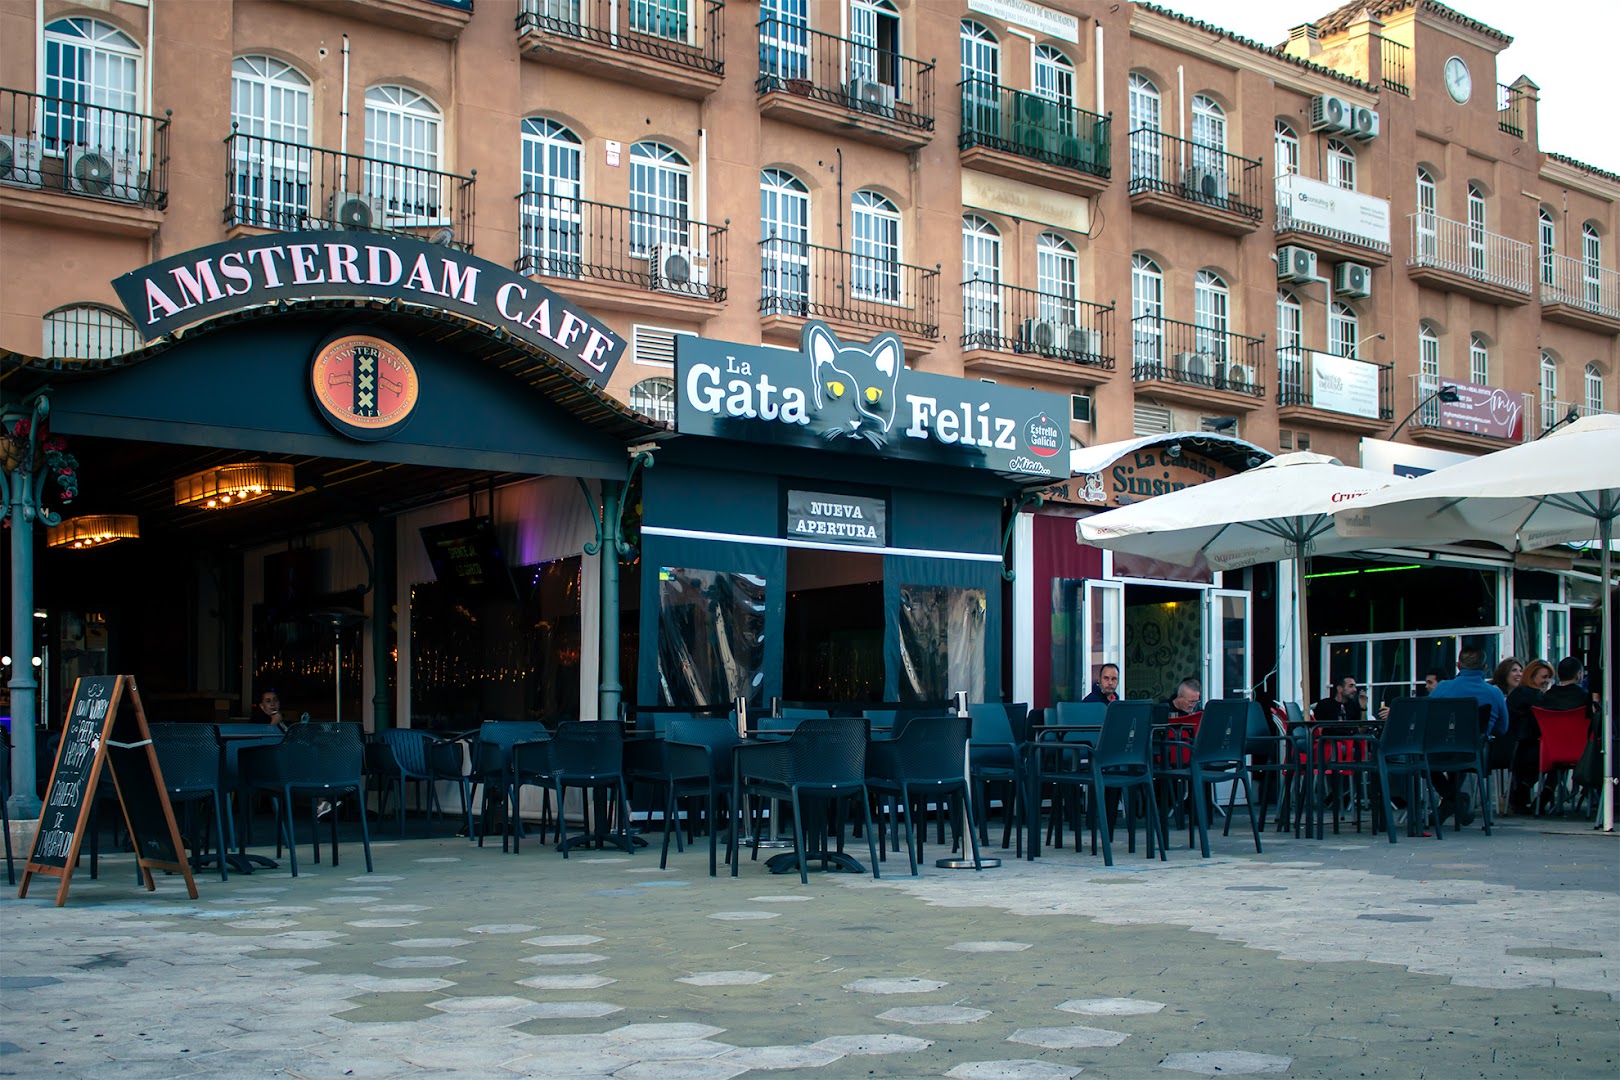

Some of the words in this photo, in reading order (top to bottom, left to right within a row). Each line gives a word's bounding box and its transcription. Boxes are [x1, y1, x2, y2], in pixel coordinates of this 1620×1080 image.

[145, 243, 483, 325] AMSTERDAM
[495, 281, 616, 374] CAFE
[336, 347, 402, 373] AMSTERDAM
[726, 356, 752, 377] La
[347, 405, 384, 417] CAFE
[686, 363, 811, 425] Gata
[905, 394, 1016, 451] Felíz
[1030, 424, 1058, 438] Estrella
[1030, 434, 1057, 448] Galicia
[1134, 452, 1155, 469] La
[1160, 449, 1217, 479] Cabaña
[810, 500, 864, 520] NUEVA
[795, 519, 878, 540] APERTURA
[53, 811, 64, 829] DE
